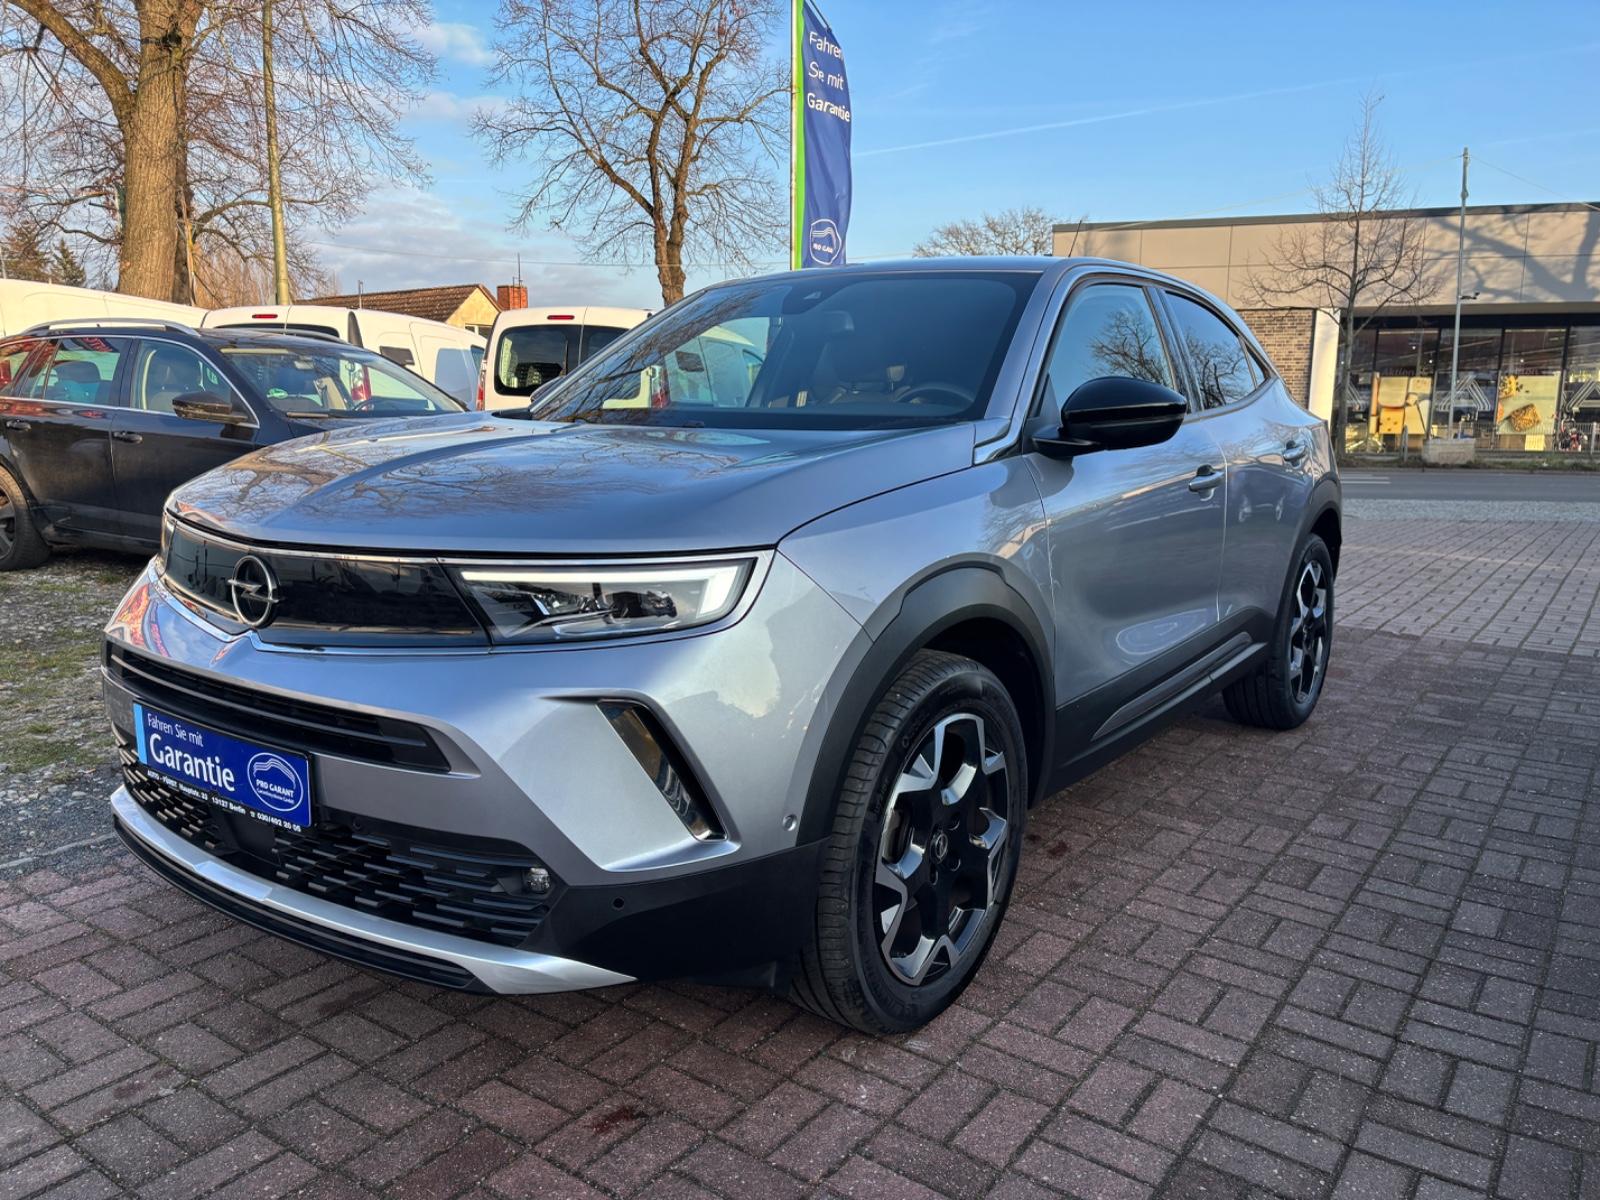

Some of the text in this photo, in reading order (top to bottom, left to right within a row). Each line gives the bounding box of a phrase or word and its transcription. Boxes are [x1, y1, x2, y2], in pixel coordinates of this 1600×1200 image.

[827, 74, 844, 90] mit
[807, 92, 851, 122] Garantie
[147, 713, 204, 747] Fahren Sie mit
[149, 733, 235, 792] Garantie
[256, 779, 294, 797] PRO GARANT
[229, 802, 246, 815] Berlin
